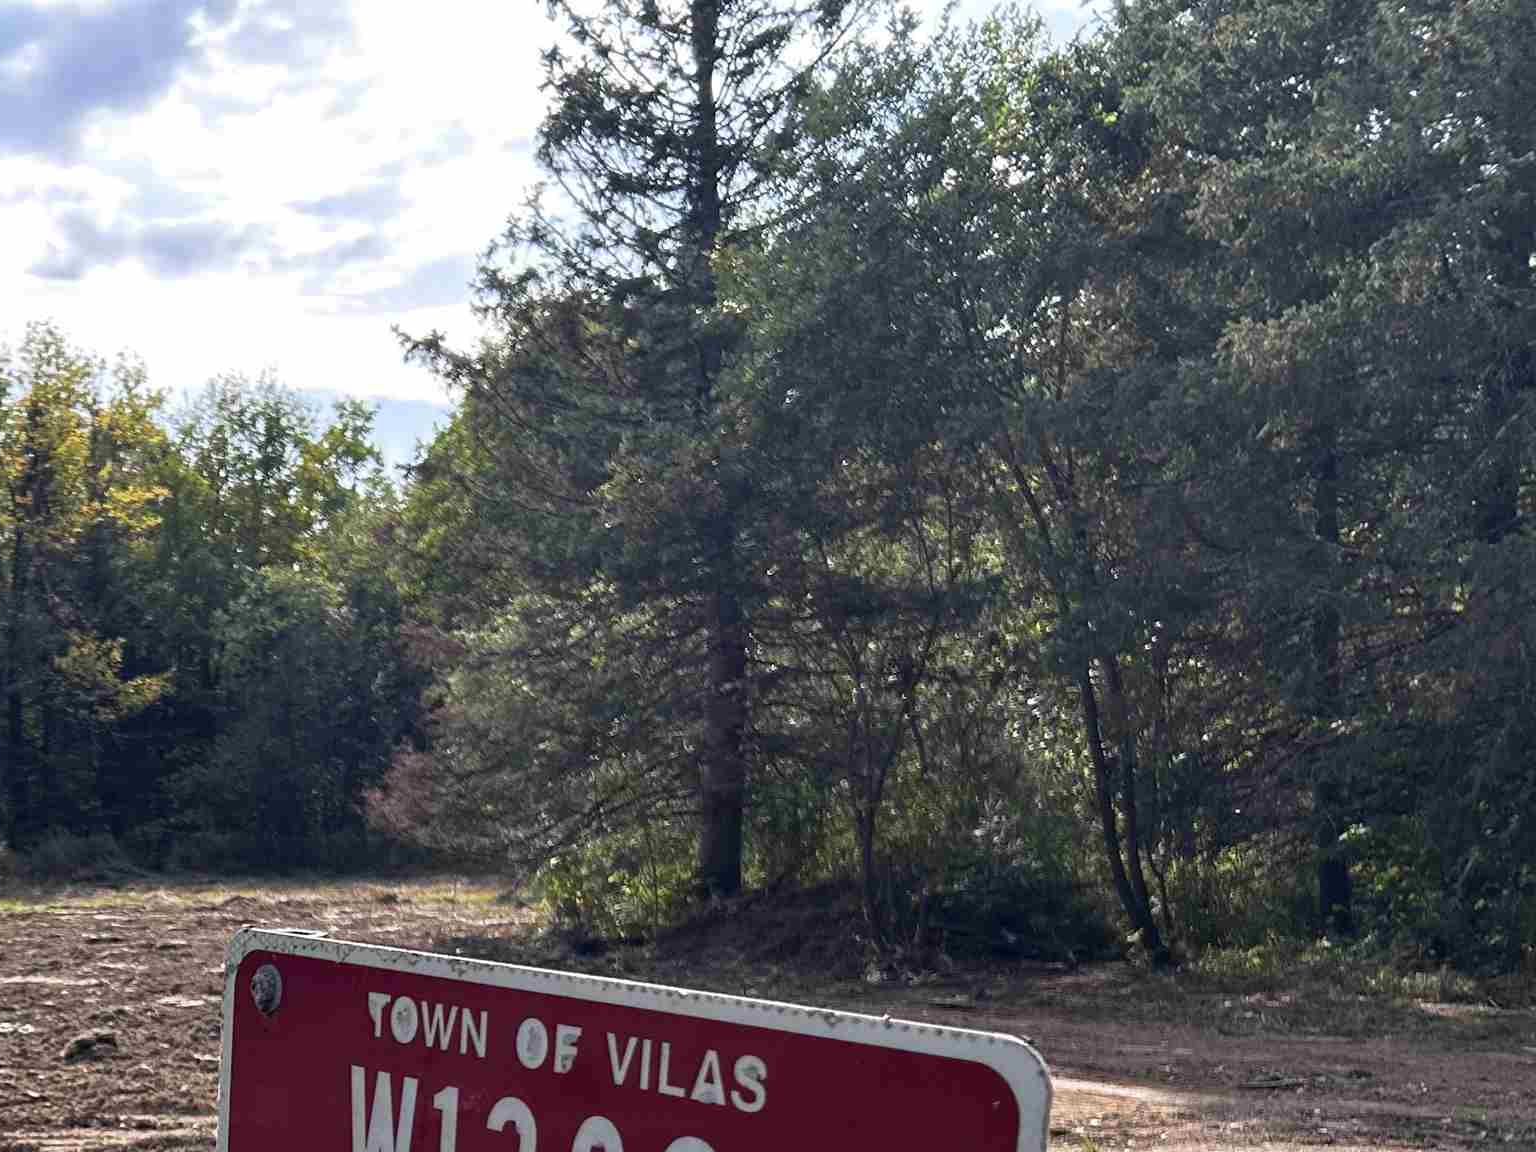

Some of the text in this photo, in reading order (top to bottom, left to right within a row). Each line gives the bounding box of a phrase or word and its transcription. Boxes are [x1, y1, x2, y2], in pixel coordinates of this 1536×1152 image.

[368, 992, 768, 1113] TOWN OF VILAS
